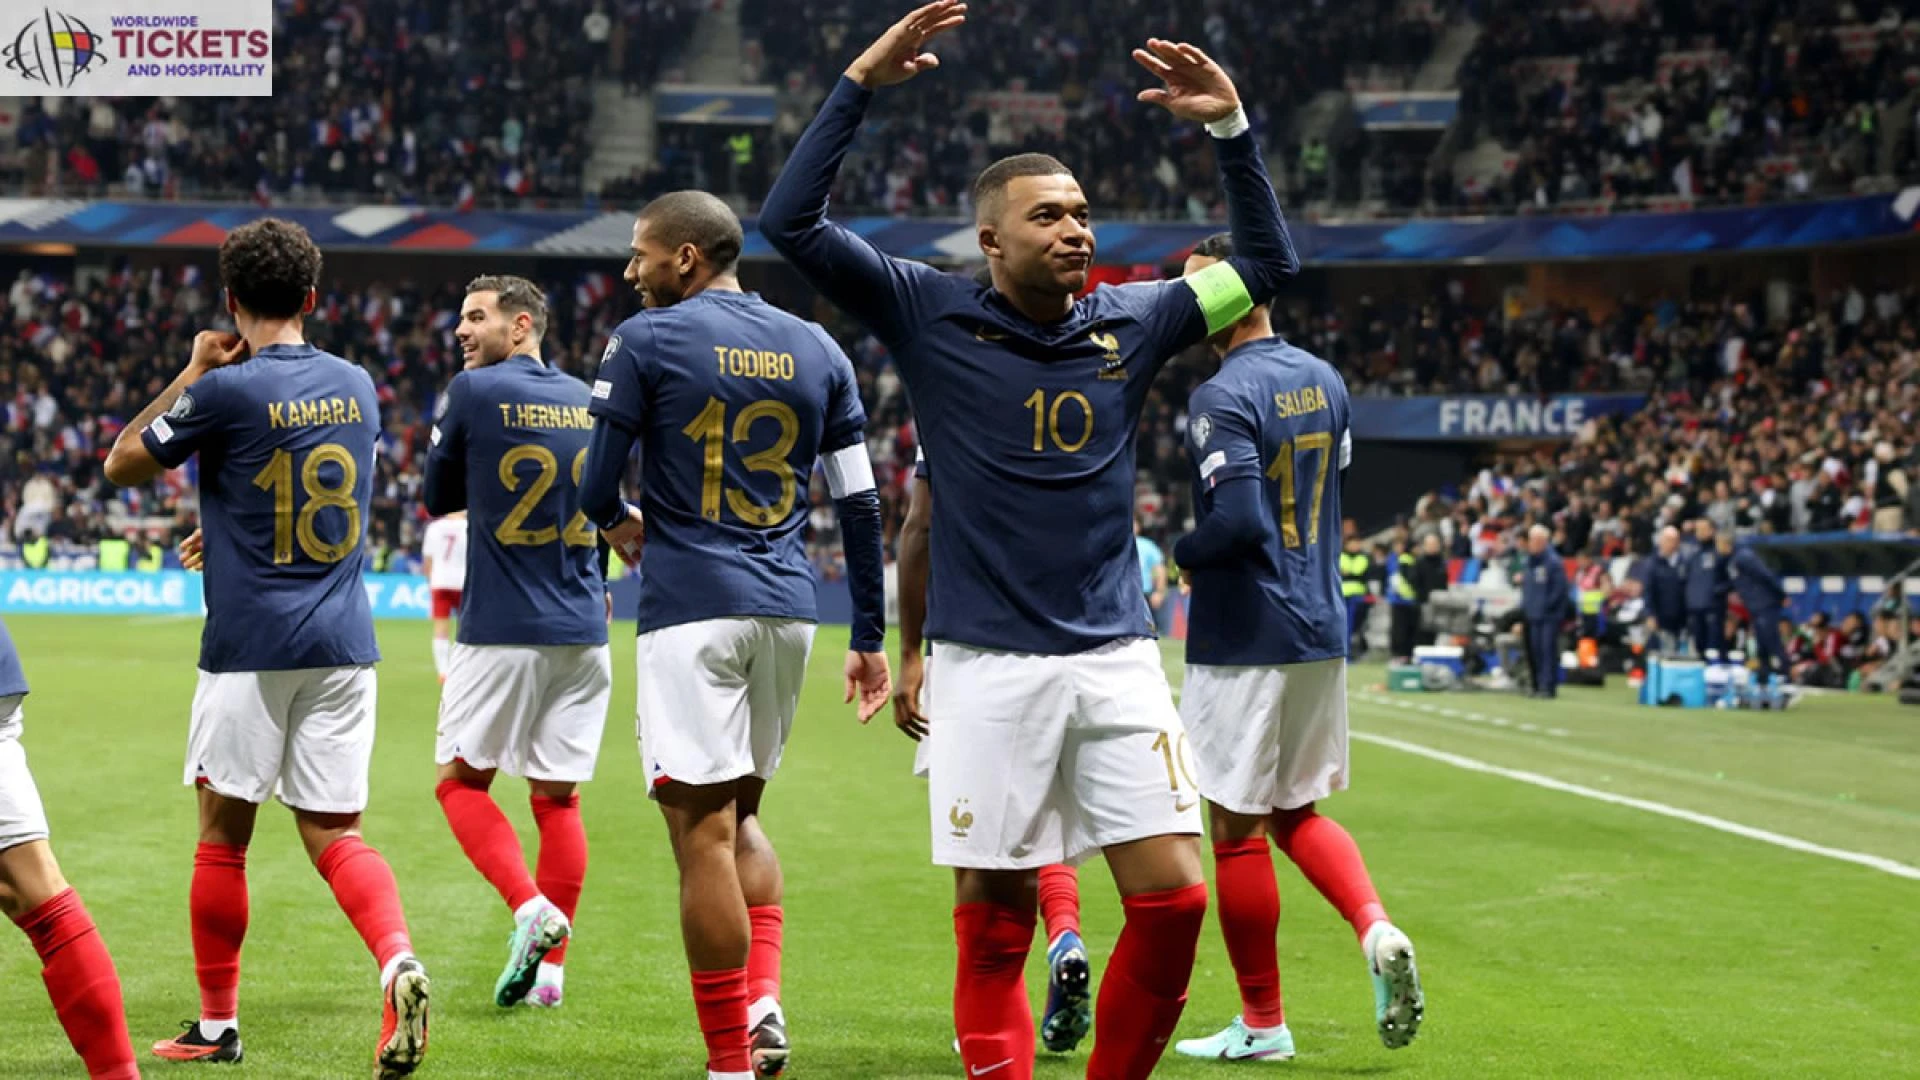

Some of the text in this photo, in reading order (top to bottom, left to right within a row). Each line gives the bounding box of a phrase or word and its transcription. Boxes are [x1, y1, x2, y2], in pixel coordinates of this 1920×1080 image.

[714, 345, 795, 381] TODIBO
[268, 397, 363, 429] KAMARA
[498, 403, 593, 430] T.HERNAND
[1275, 385, 1329, 419] SALIBA
[1439, 399, 1587, 436] FRANCE
[1023, 388, 1093, 453] 10
[681, 395, 800, 527] 13
[252, 442, 361, 564] 18
[1265, 430, 1334, 548] 17
[443, 534, 458, 562] 7
[7, 577, 185, 606] AGRICOLE
